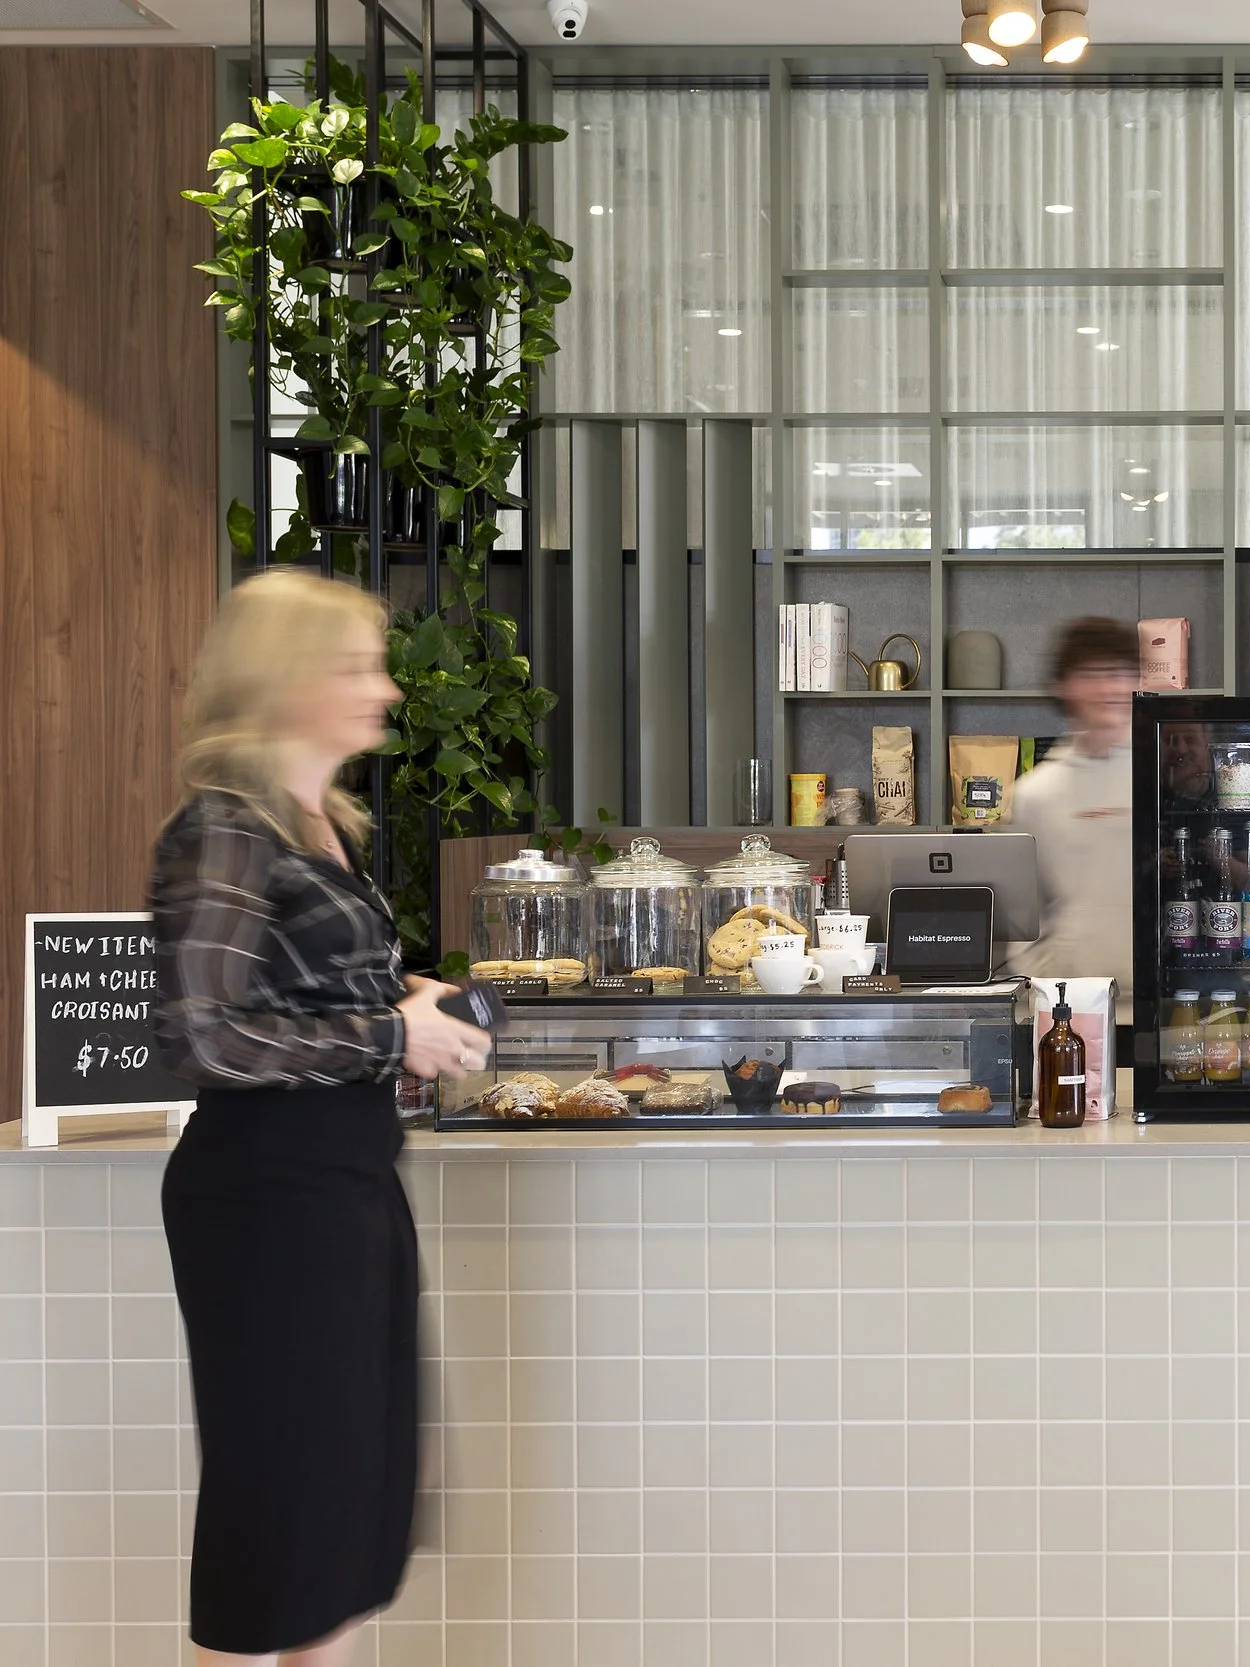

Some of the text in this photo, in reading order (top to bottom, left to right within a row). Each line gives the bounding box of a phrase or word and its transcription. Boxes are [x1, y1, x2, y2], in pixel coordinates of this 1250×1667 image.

[1211, 907, 1236, 917] RIVER
[1213, 923, 1234, 932] PORT
[937, 935, 971, 944] Espresso
[41, 971, 91, 989] HAM
[51, 1000, 150, 1020] CROISANT
